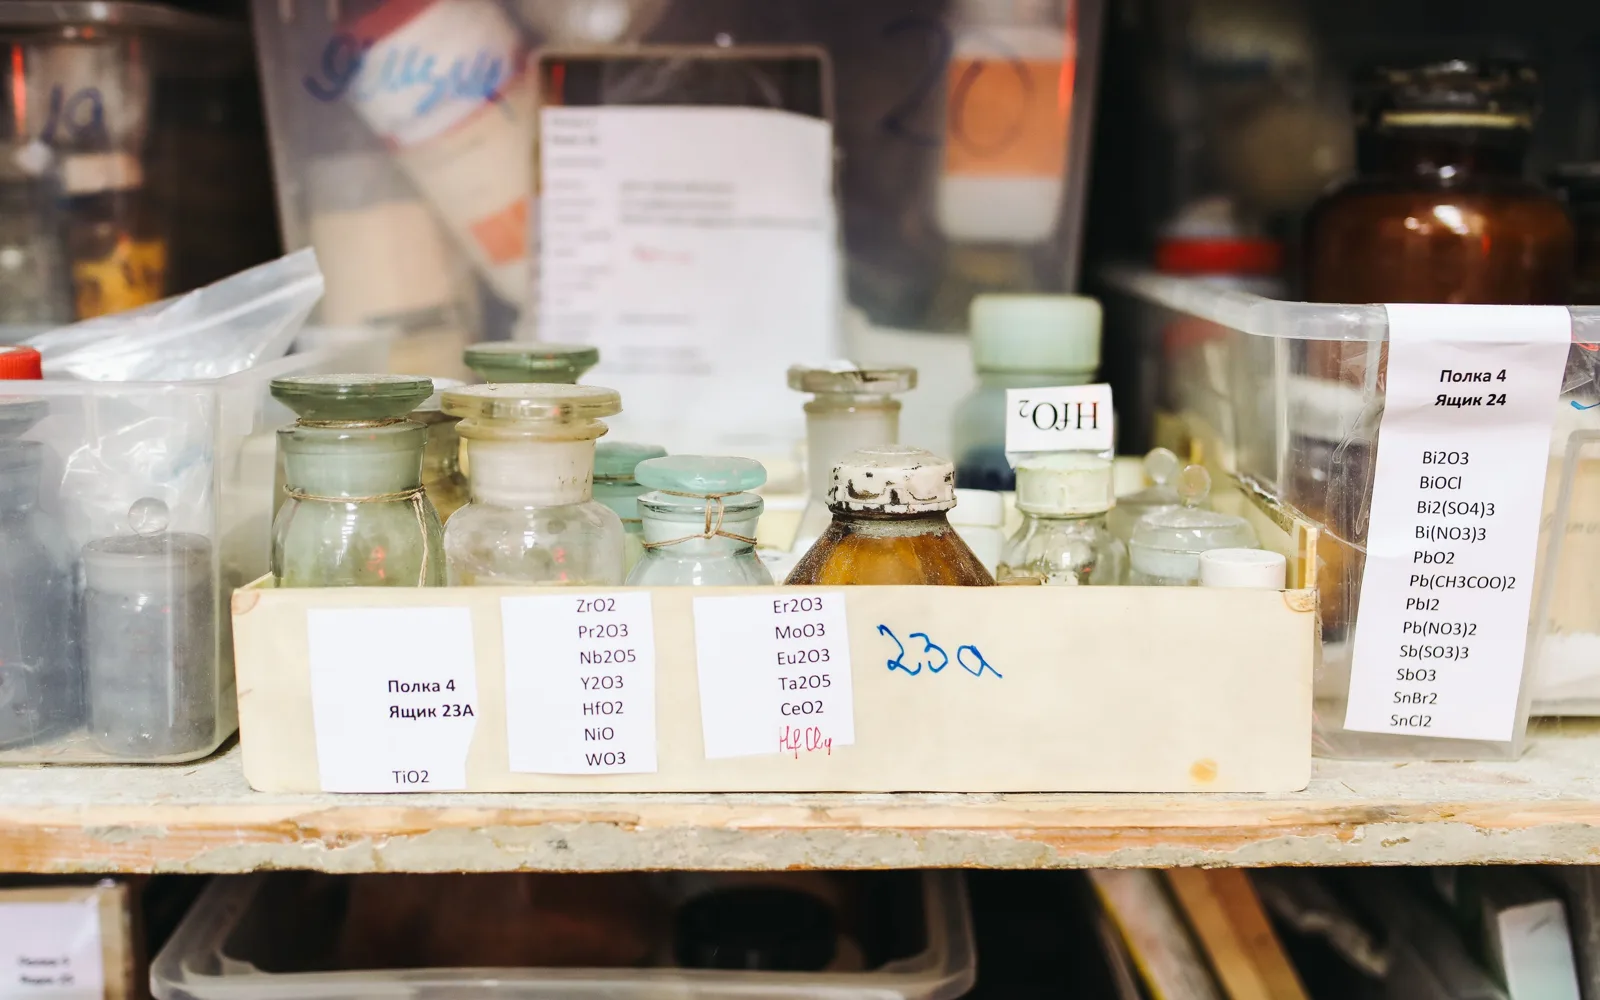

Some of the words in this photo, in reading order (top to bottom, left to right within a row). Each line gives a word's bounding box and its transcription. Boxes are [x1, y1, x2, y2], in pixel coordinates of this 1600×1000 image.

[1439, 369, 1492, 383] Полка
[1495, 368, 1507, 383] 4
[1433, 393, 1483, 409] Ящик
[1485, 393, 1507, 407] 24
[1422, 450, 1469, 466] Bi2O3
[1419, 475, 1462, 490] BiOCl
[1416, 500, 1495, 519] Bi2(SO4)3
[1415, 524, 1487, 544] Bi(NO3)3
[1413, 550, 1455, 565] PbO2
[1409, 573, 1516, 592] Pb(CH3COO)2
[576, 598, 616, 613] ZrO2
[773, 596, 823, 614] Er2O3
[1405, 597, 1440, 611] PbI2
[578, 623, 629, 639] Pr2O3
[775, 622, 826, 640] MoO3
[1402, 620, 1477, 639] Pb(NO3)2
[580, 648, 636, 665] Nb2O5
[777, 648, 831, 666] Eu2O3
[1399, 644, 1469, 662] Sb(SO3)3
[777, 673, 831, 691] Ta2O5
[1396, 667, 1437, 682] SbO3
[387, 679, 441, 693] Полка
[445, 678, 456, 692] 4
[580, 675, 624, 691] Y2O3
[1393, 691, 1438, 705] SnBr2
[389, 705, 437, 721] Ящик
[582, 700, 624, 716] HfO2
[780, 699, 824, 716] CeO2
[1390, 714, 1432, 728] SnCl2
[584, 726, 615, 742] NiO
[585, 751, 626, 767] WO3
[391, 769, 430, 784] TiO2
